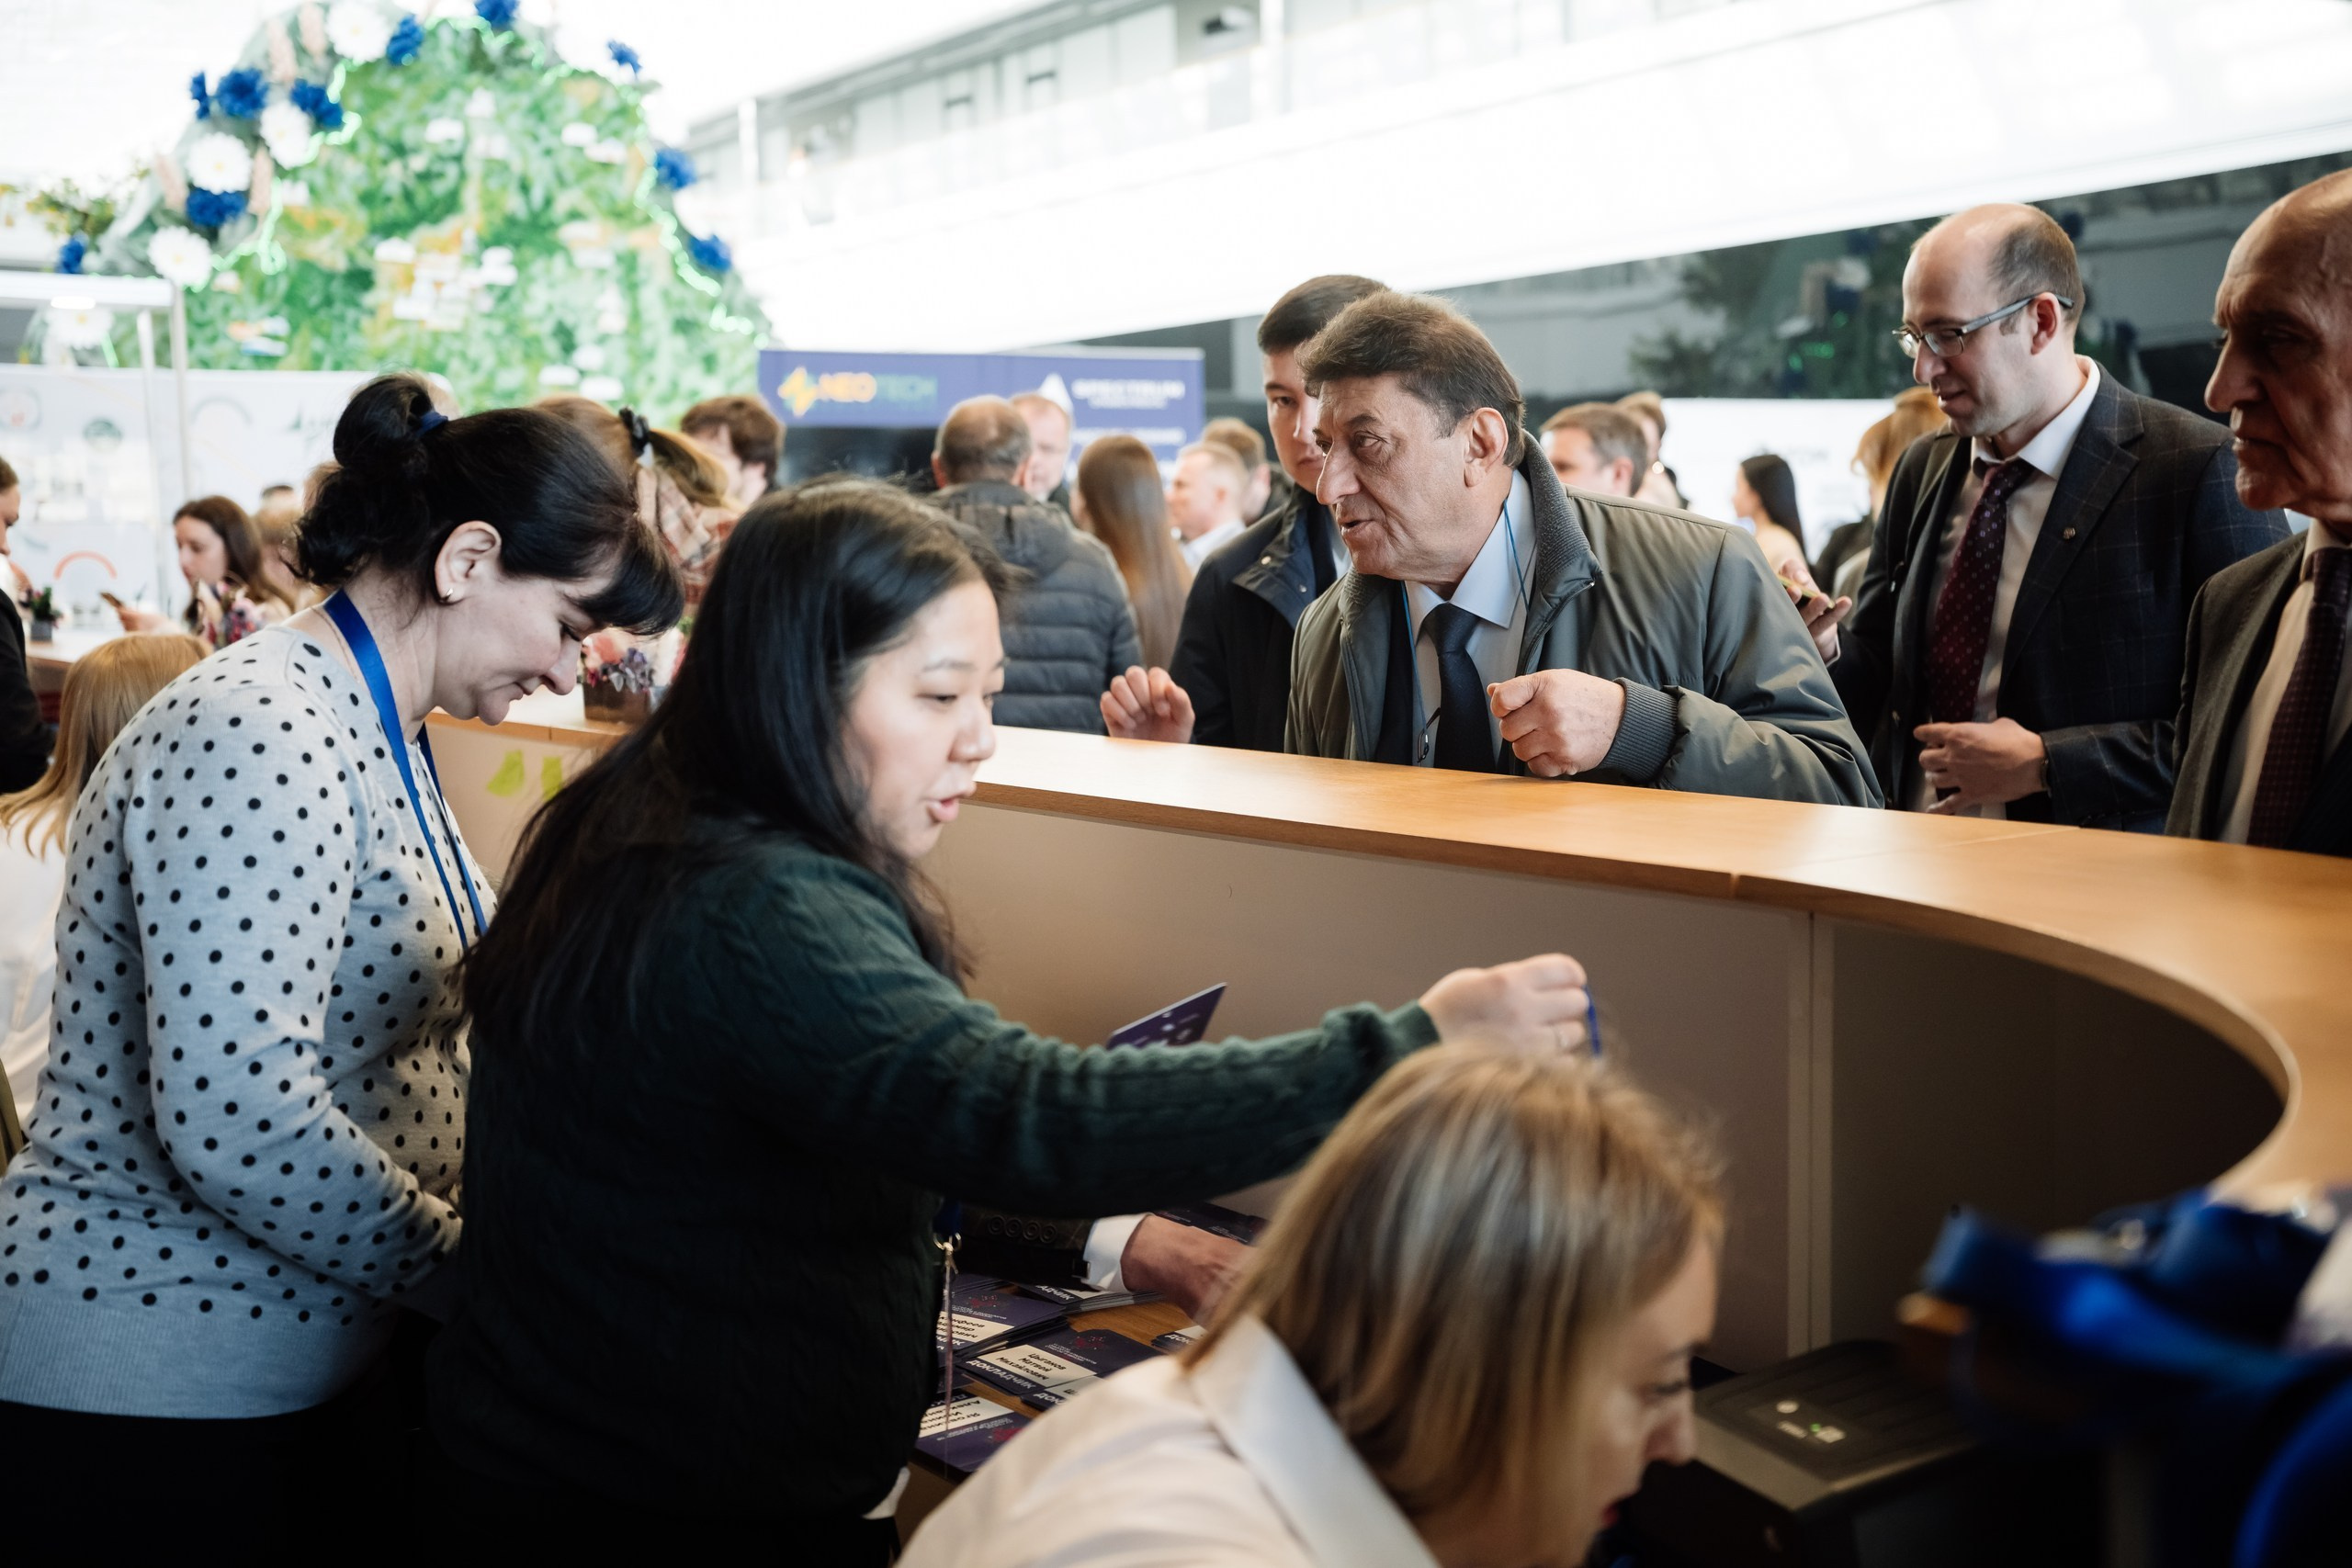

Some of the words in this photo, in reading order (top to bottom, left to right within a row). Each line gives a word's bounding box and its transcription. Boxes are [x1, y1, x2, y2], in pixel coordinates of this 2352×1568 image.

[996, 1357, 1049, 1380] Михайлович
[1019, 1358, 1053, 1372] Матвей
[1028, 1353, 1066, 1370] Цыганов
[966, 1359, 1037, 1389] ДОКЛАДЧИК
